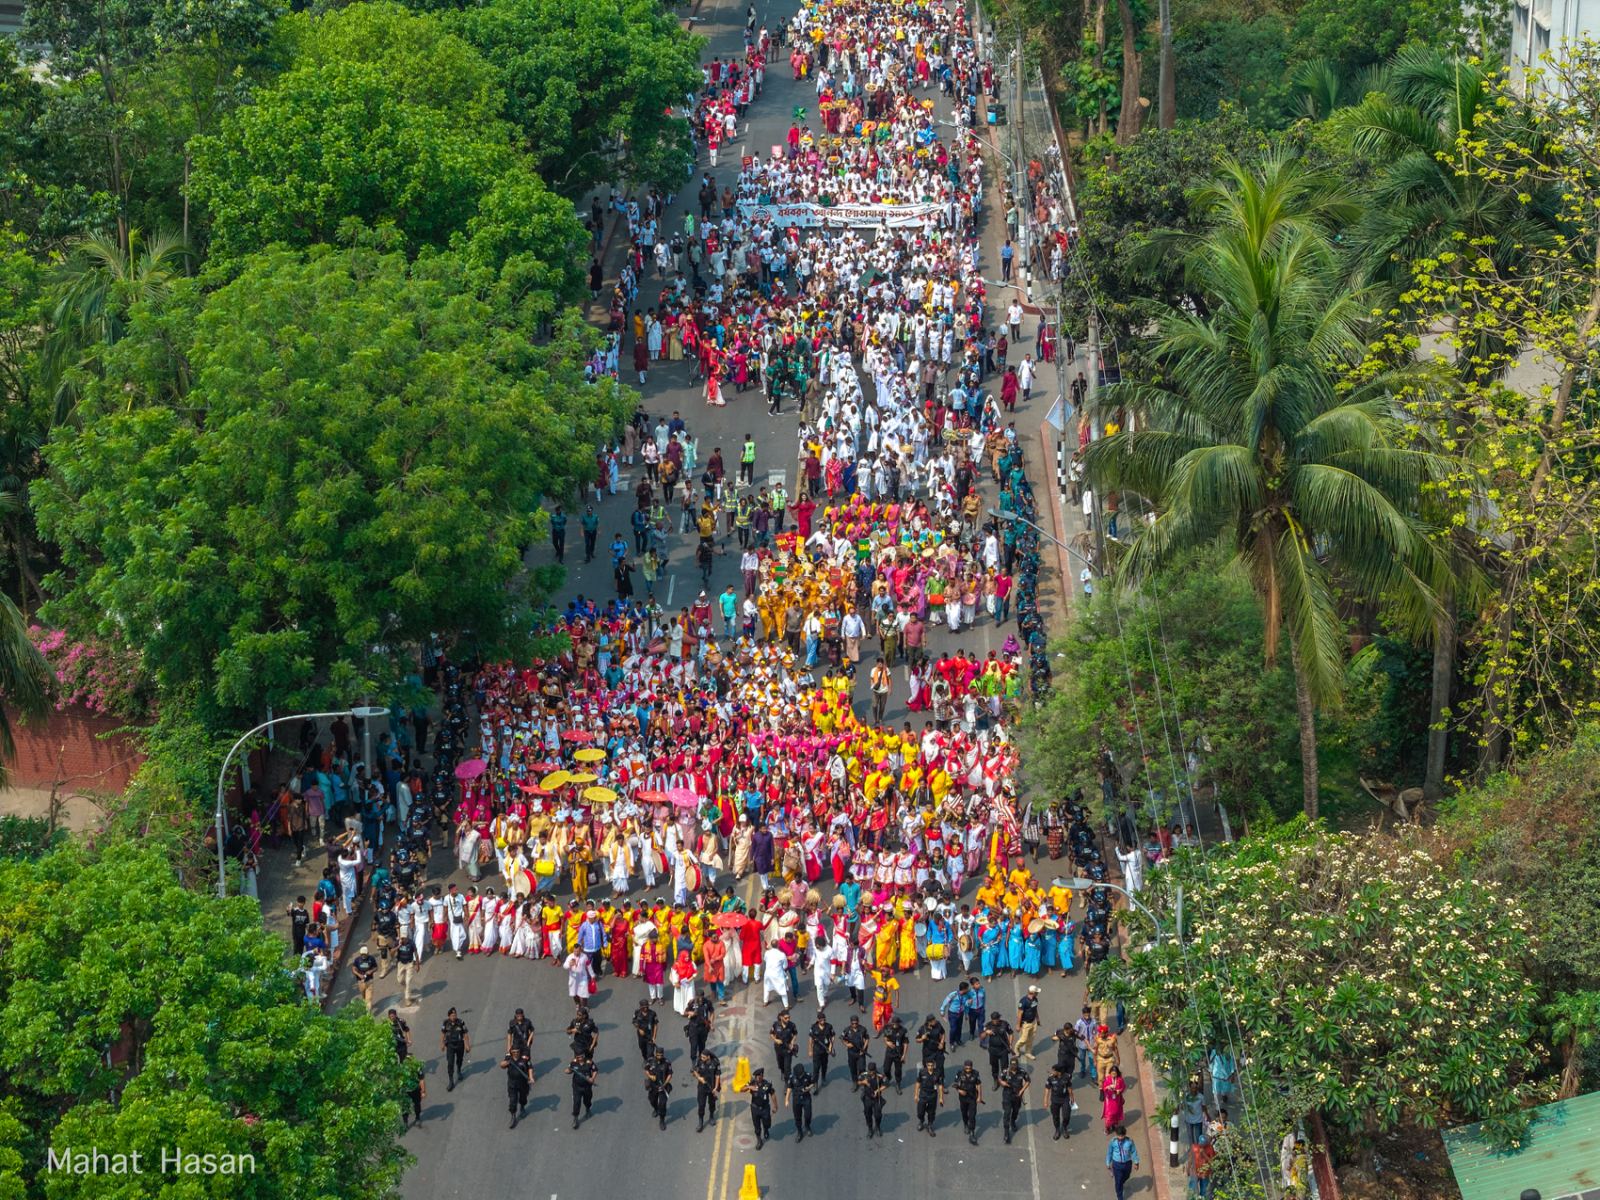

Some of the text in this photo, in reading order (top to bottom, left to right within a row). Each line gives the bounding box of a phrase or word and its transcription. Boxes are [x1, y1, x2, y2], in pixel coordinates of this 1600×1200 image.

[778, 207, 914, 218] বর্ষবরণ আনন্দ শোভাযাত্রা ১৪৩২
